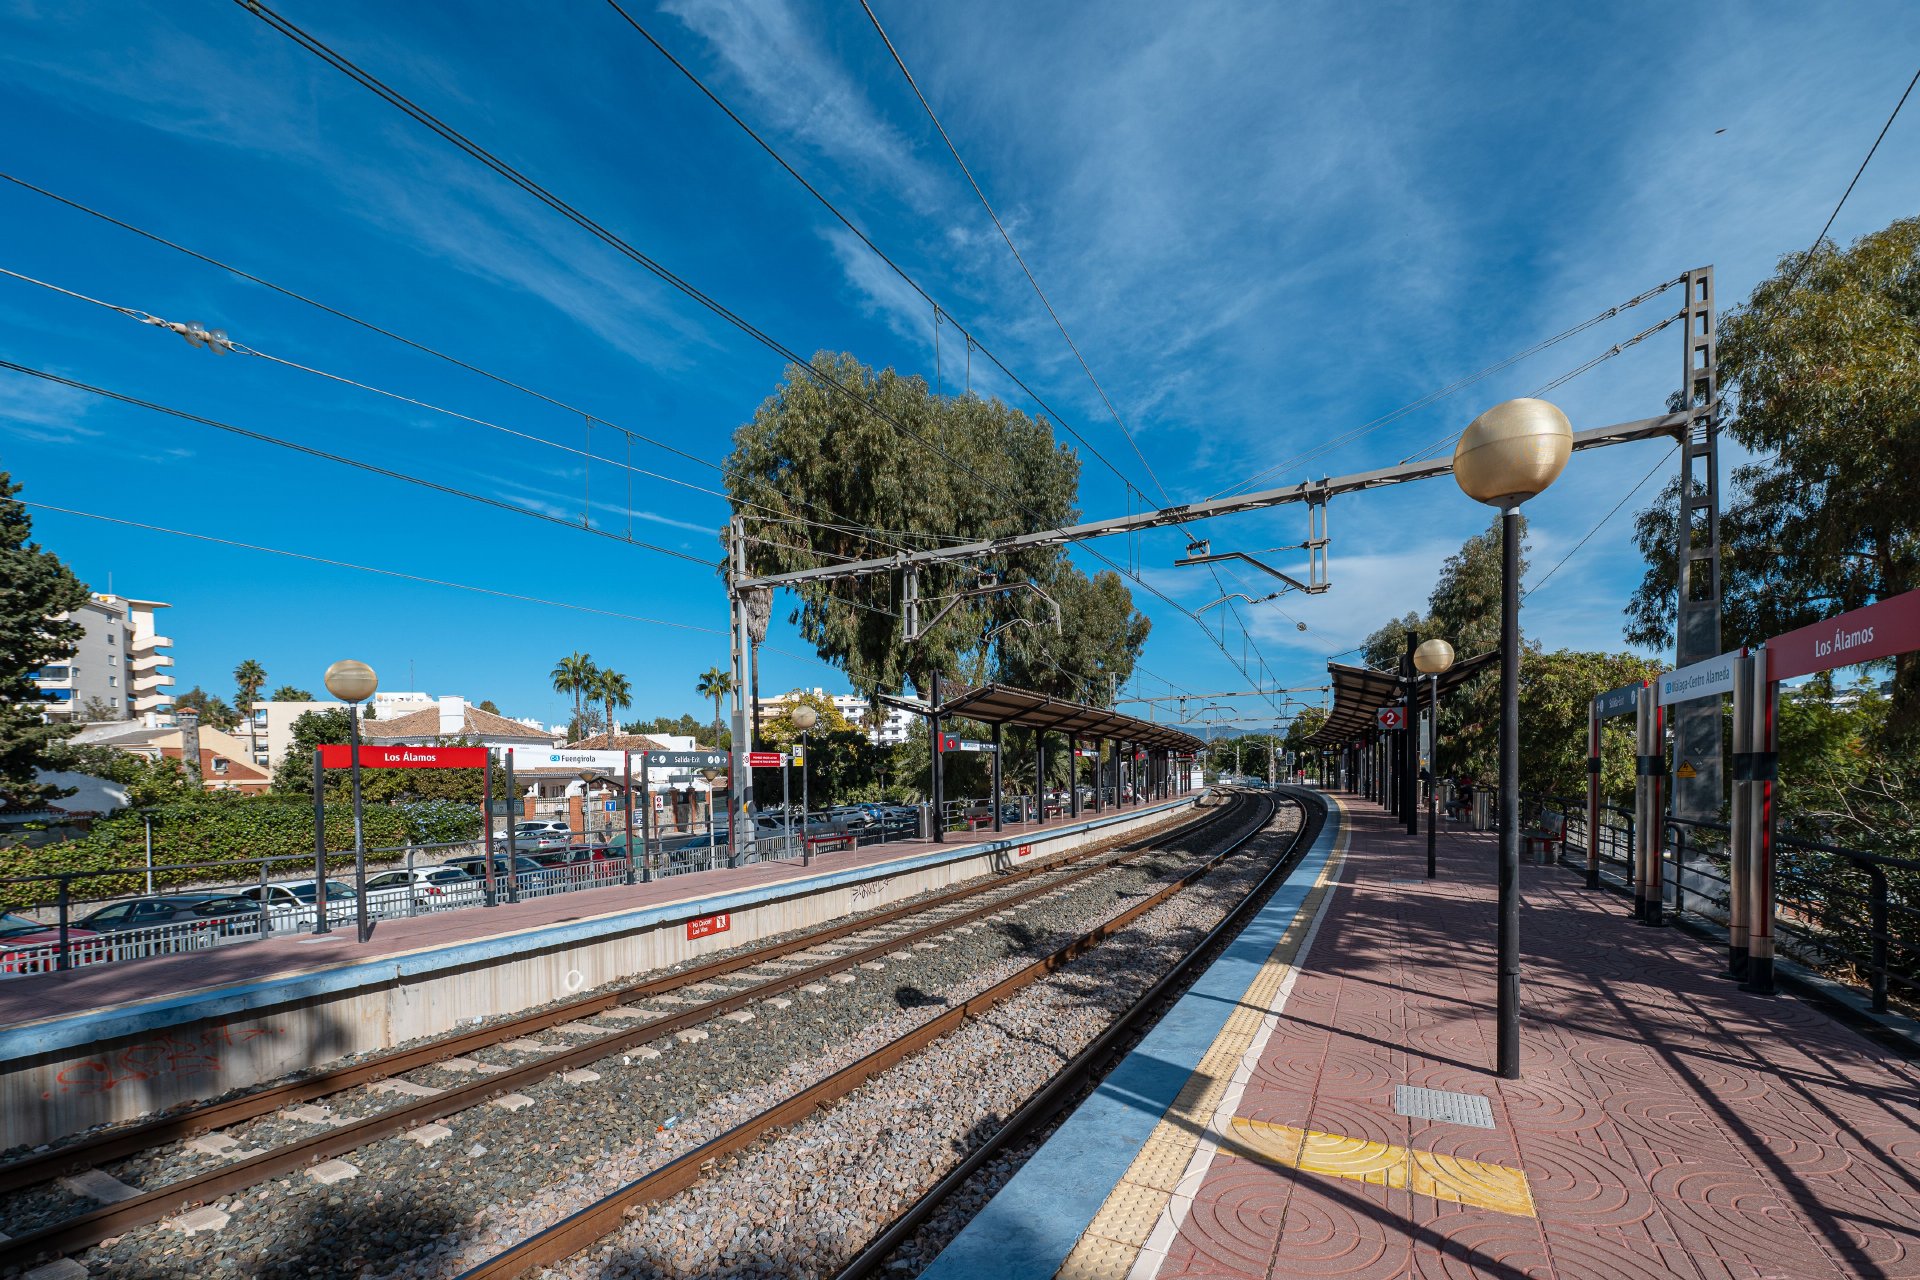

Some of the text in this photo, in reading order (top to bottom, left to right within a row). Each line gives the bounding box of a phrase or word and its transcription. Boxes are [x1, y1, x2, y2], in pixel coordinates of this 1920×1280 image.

[1815, 626, 1874, 658] Los Álamos
[1705, 665, 1730, 684] Alameda
[1386, 712, 1394, 724] 2
[384, 751, 436, 762] Los Álamos
[561, 754, 596, 764] Fuengirola
